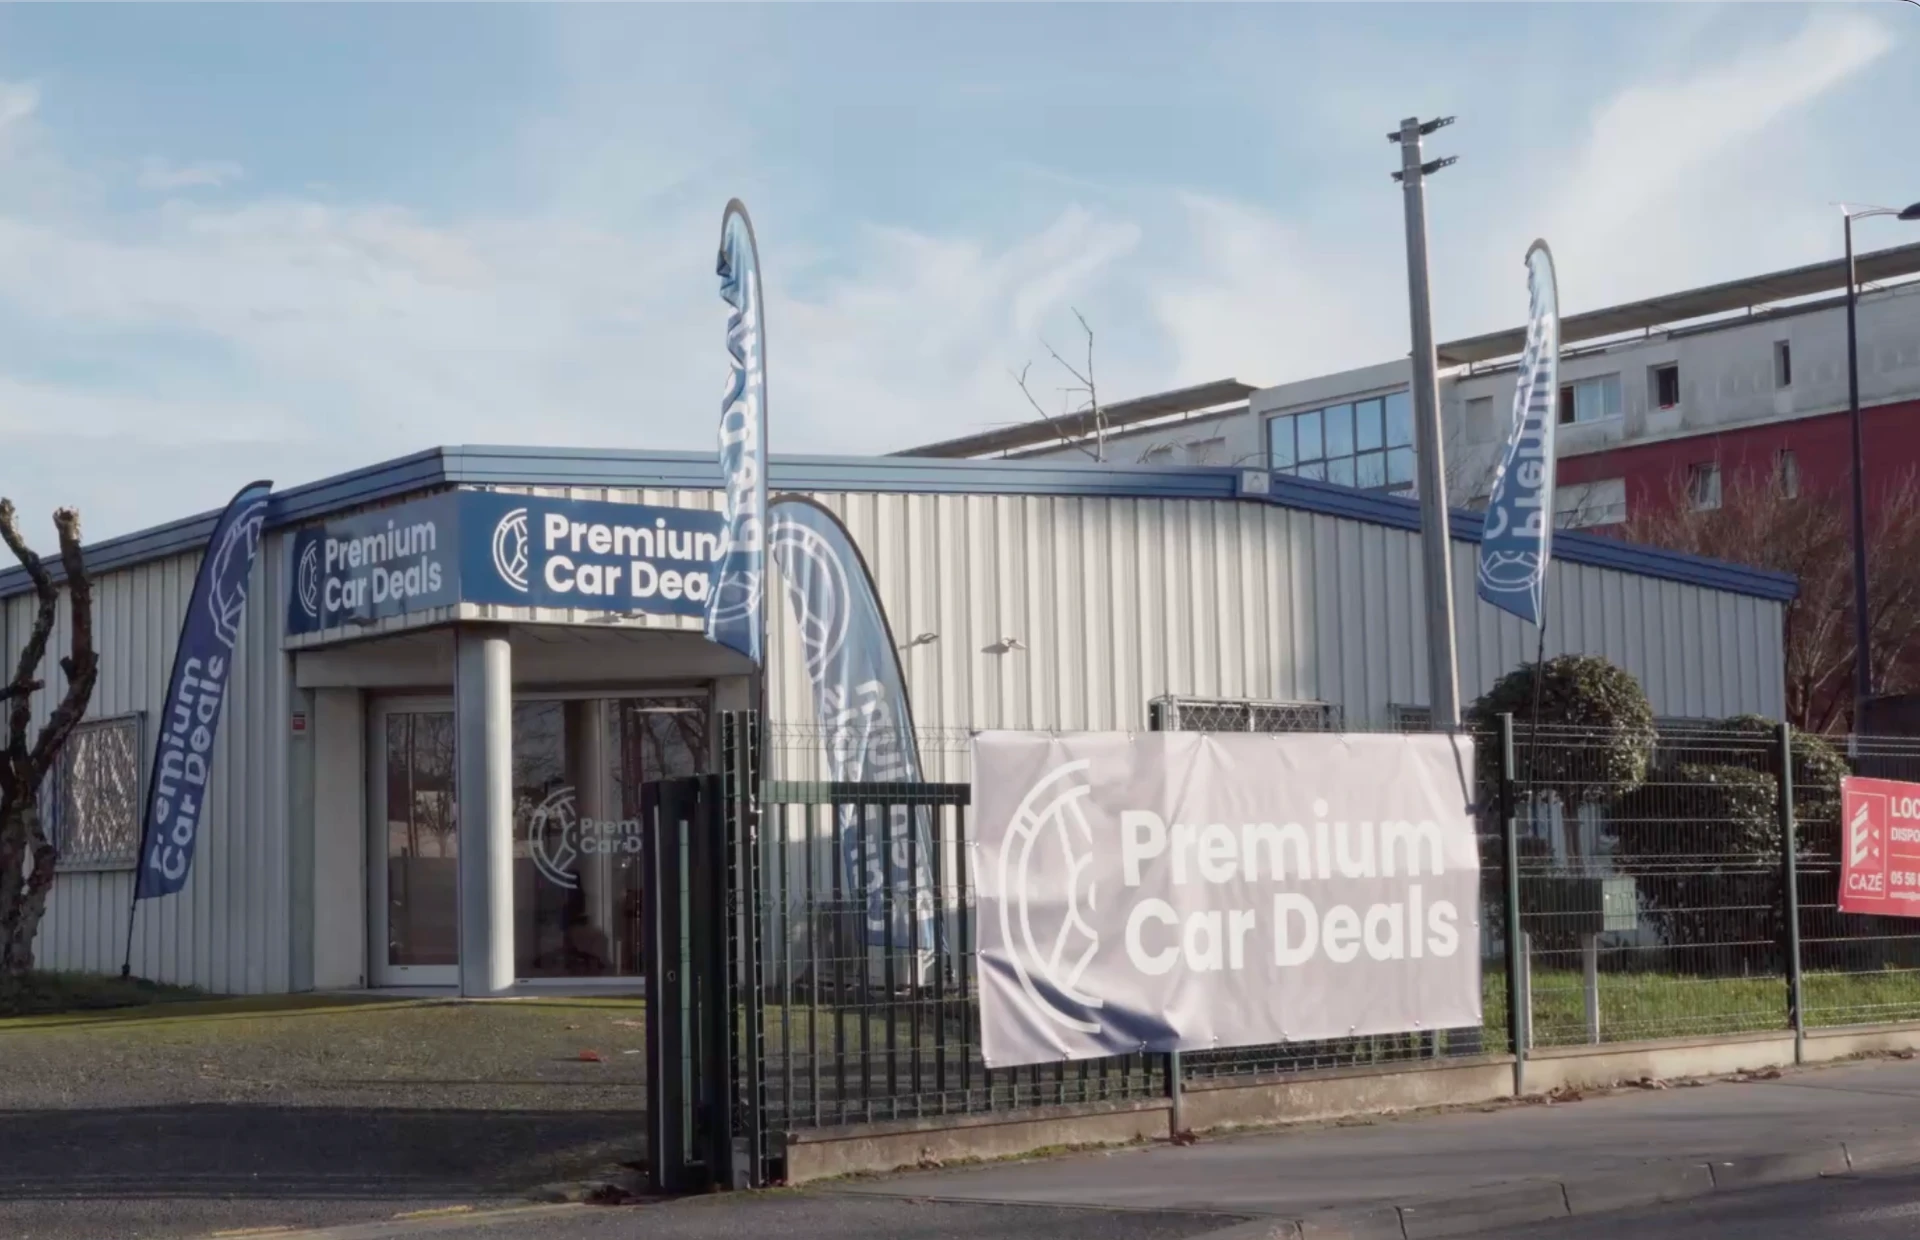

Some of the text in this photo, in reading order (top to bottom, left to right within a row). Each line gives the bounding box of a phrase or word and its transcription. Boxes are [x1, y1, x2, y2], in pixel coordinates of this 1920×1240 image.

[325, 519, 436, 574] Premium
[325, 555, 442, 612] Car Deals
[545, 555, 710, 601] Car Dea
[163, 794, 195, 880] Car
[580, 816, 640, 835] Prem
[580, 836, 621, 854] Car
[1120, 798, 1444, 887] Premium
[1849, 872, 1883, 891] CAZÉ
[1124, 884, 1459, 976] Car Deals
